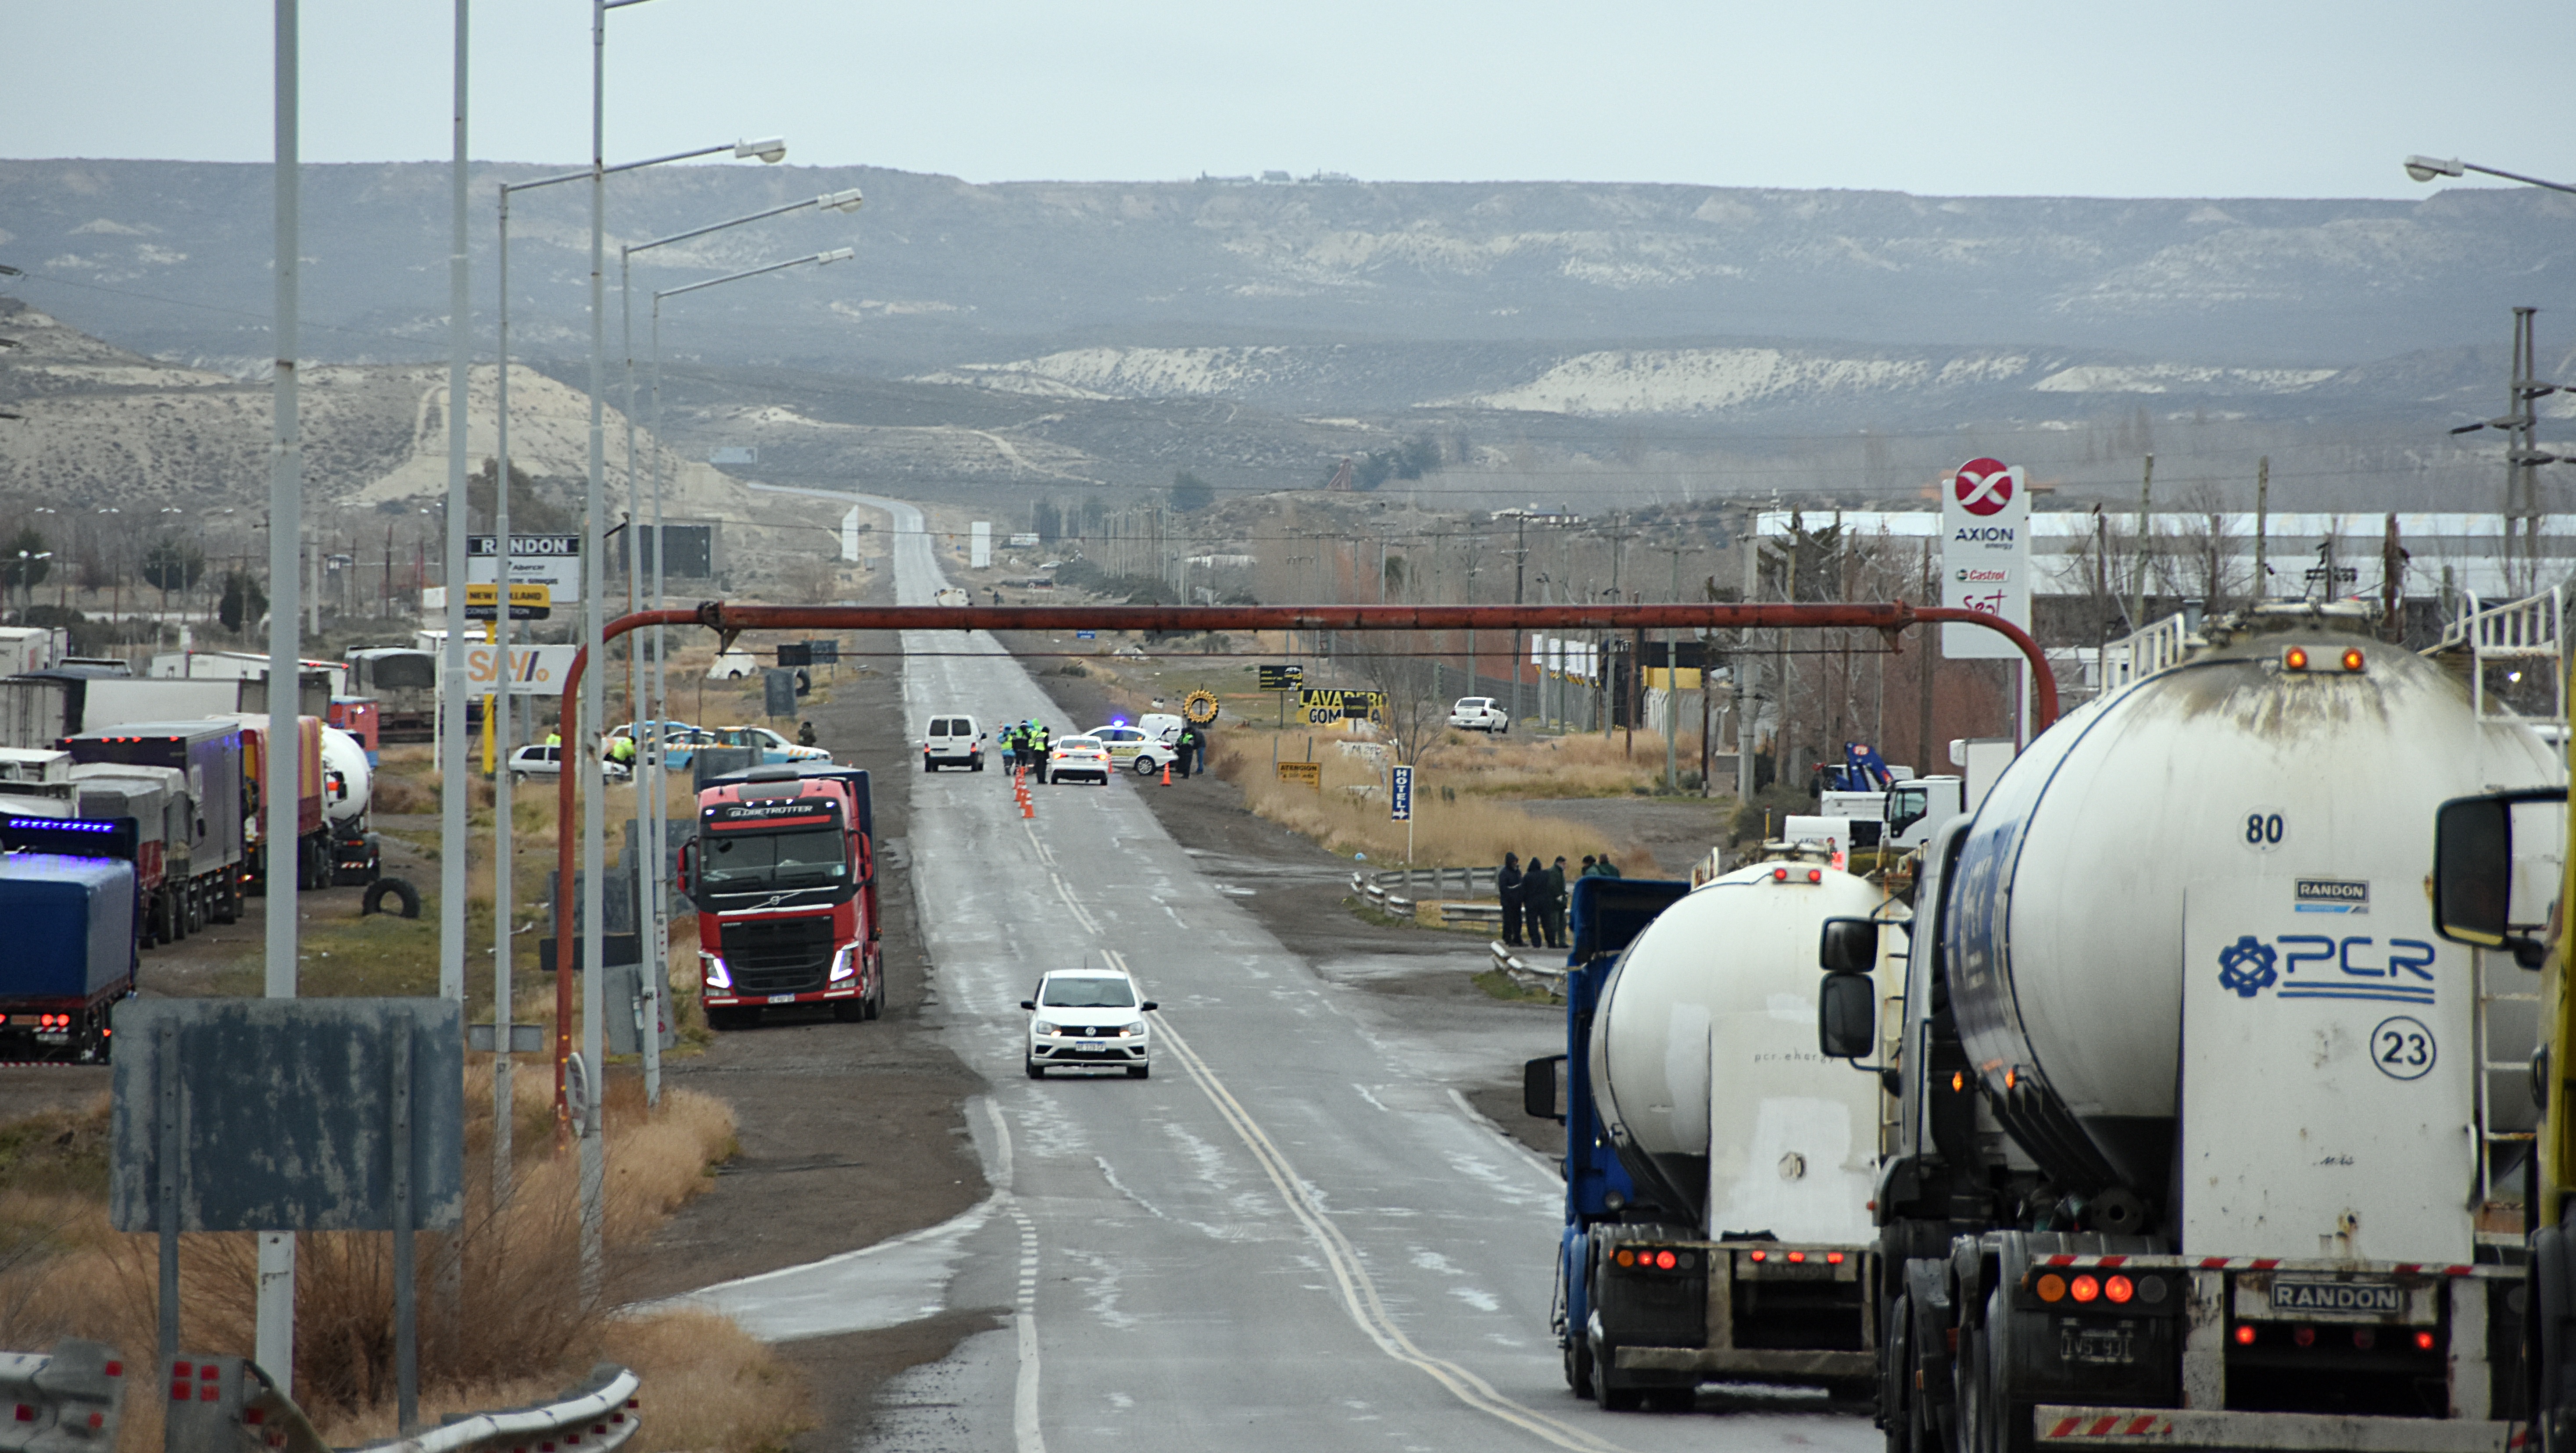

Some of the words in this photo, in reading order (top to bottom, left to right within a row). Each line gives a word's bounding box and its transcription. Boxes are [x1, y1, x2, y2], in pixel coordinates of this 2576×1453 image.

[1955, 527, 2014, 541] AXION
[481, 539, 568, 553] RNDON
[1970, 569, 2006, 580] Castrol
[1395, 769, 1407, 809] HOTEL
[2246, 813, 2283, 844] 80
[2300, 883, 2364, 898] RANDON
[2277, 935, 2436, 981] PCR
[2382, 1031, 2427, 1065] 23
[2276, 1286, 2397, 1307] RANDON
